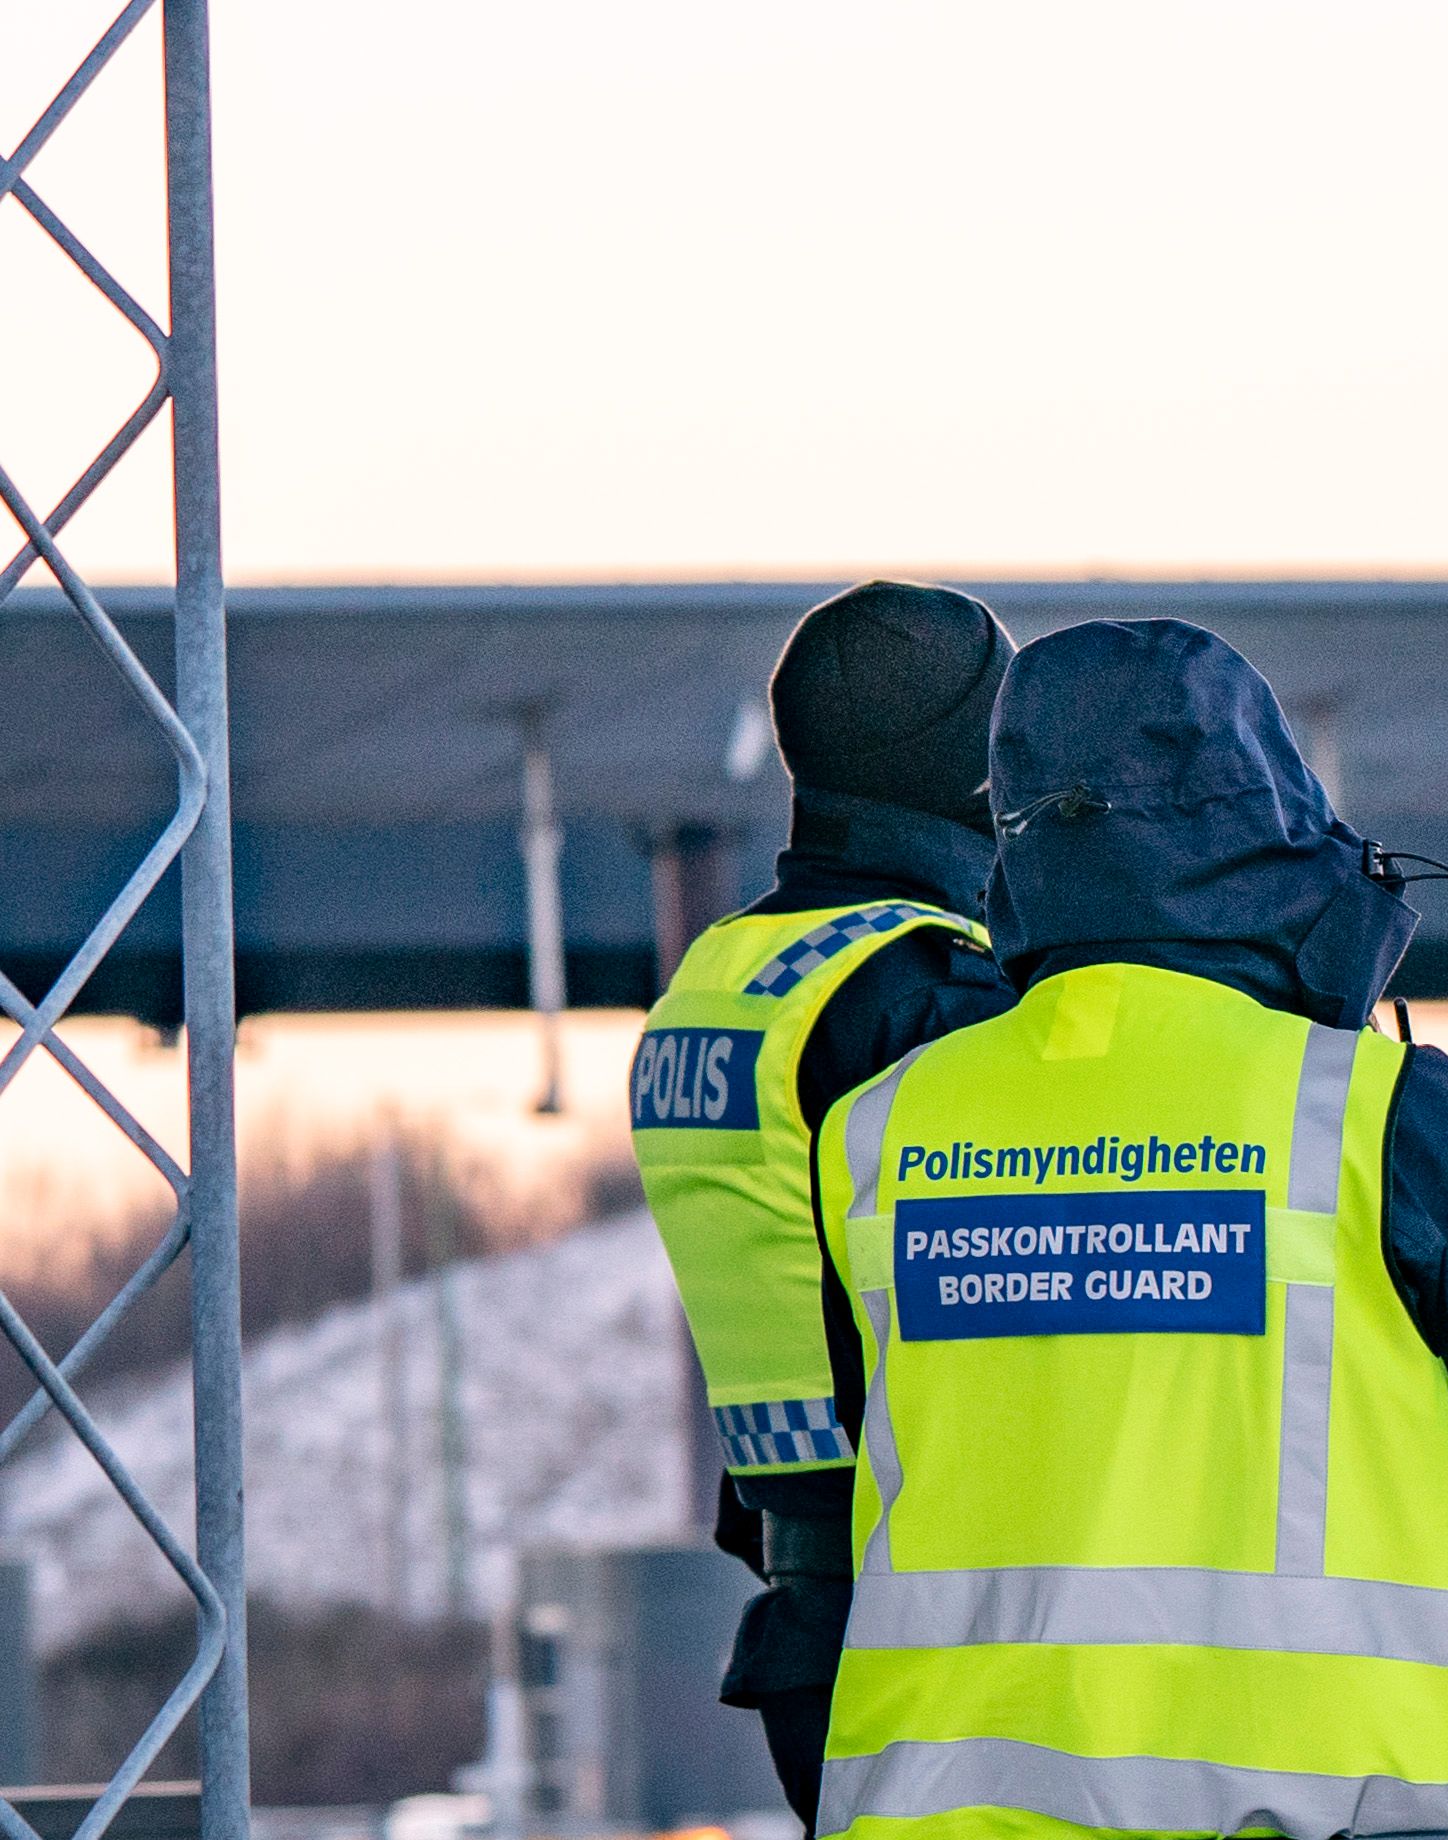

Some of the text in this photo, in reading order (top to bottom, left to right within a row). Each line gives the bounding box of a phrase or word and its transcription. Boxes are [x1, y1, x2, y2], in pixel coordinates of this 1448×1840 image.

[635, 1035, 733, 1121] POLIS
[898, 1135, 1267, 1185] Polismyndigheten
[906, 1223, 1252, 1260] PASSKONTROLLANT
[939, 1269, 1213, 1306] BORDER GUARD
